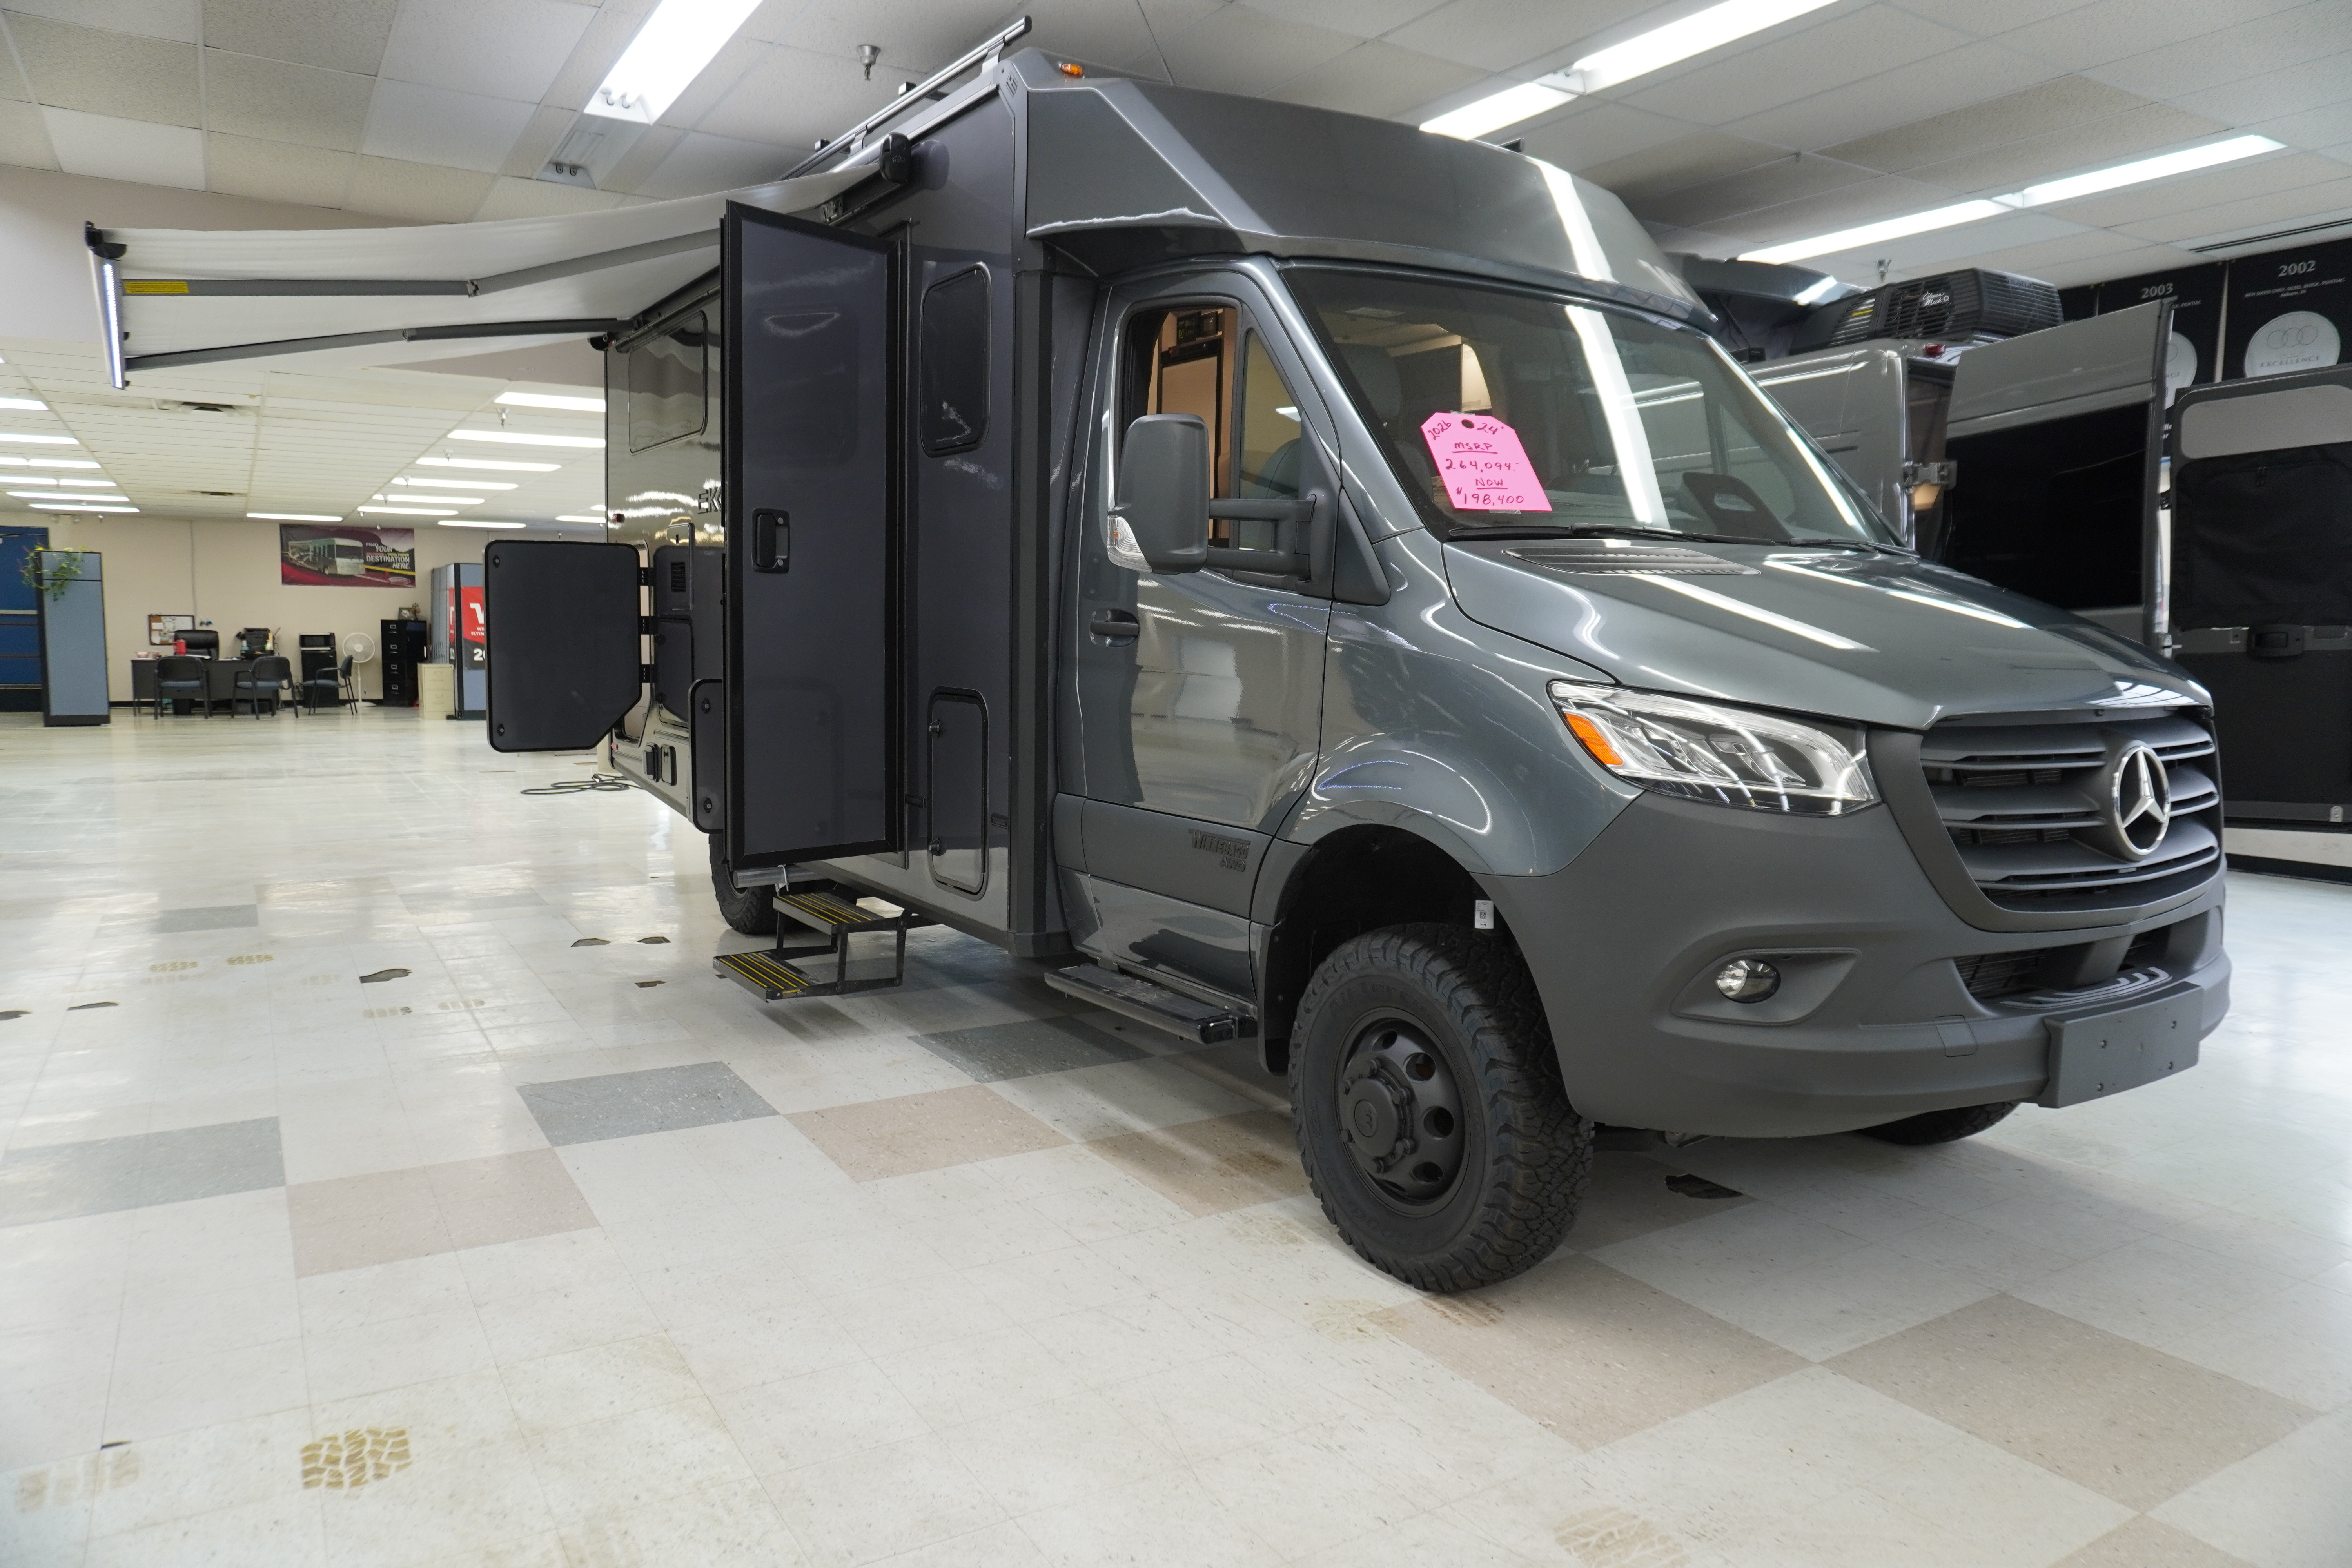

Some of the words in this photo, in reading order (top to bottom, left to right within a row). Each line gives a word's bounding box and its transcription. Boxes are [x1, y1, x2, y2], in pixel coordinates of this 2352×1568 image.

[2278, 260, 2316, 277] 2002
[1923, 291, 1945, 300] Coleman
[2141, 283, 2173, 298] 2003
[1924, 297, 1943, 307] Mach
[2260, 356, 2319, 368] EXCELLENCE
[1428, 420, 1452, 440] 2026
[1454, 442, 1493, 450] MSRP
[1475, 478, 1503, 486] NOW
[1188, 828, 1251, 859] WINNEBAGO
[1220, 857, 1246, 872] AWD
